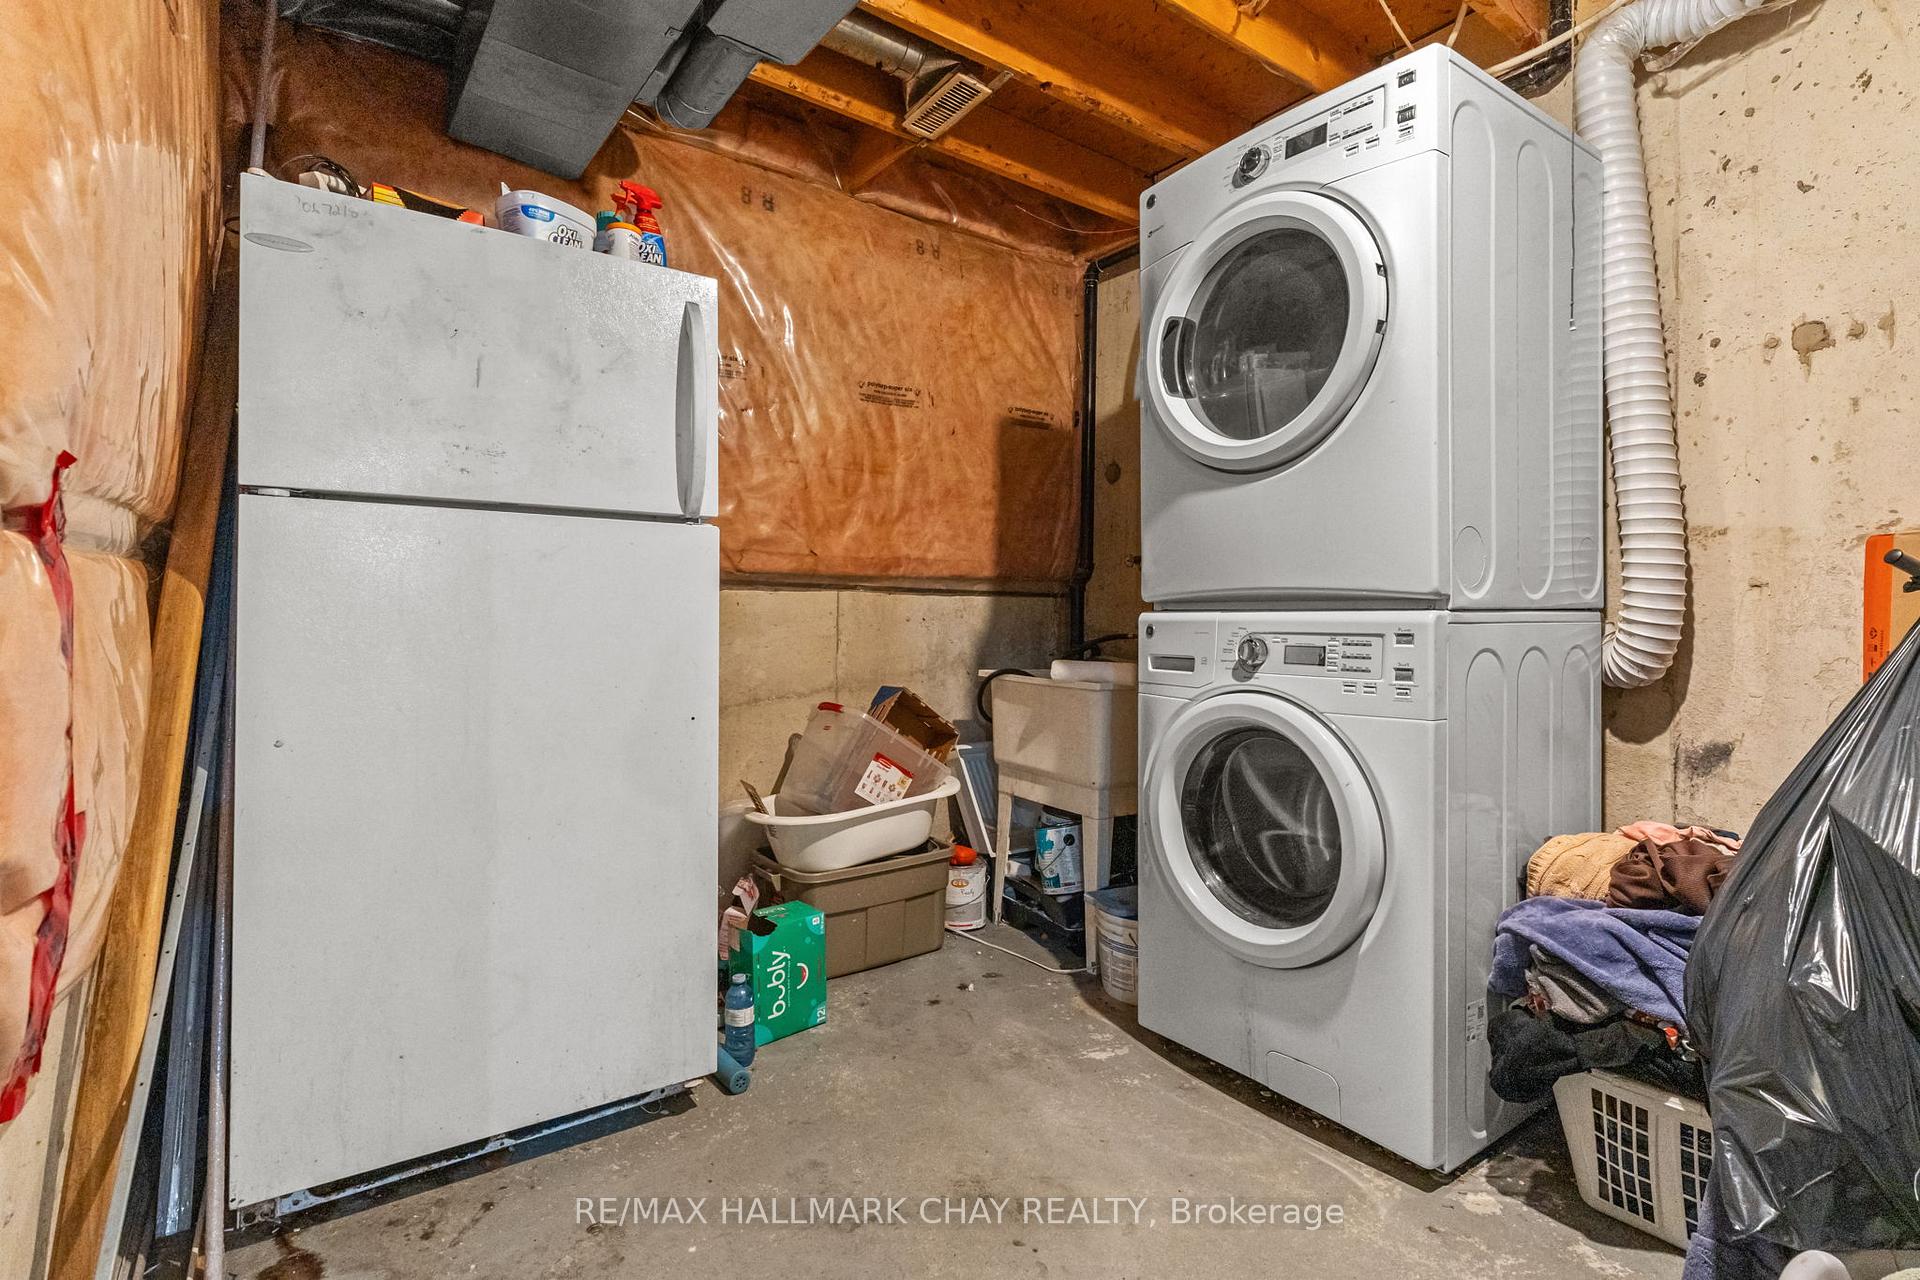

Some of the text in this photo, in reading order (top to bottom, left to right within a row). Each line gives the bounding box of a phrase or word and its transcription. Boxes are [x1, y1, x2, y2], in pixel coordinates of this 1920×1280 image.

[556, 224, 578, 240] OXI
[639, 252, 663, 265] EAN
[767, 950, 791, 1020] bubly
